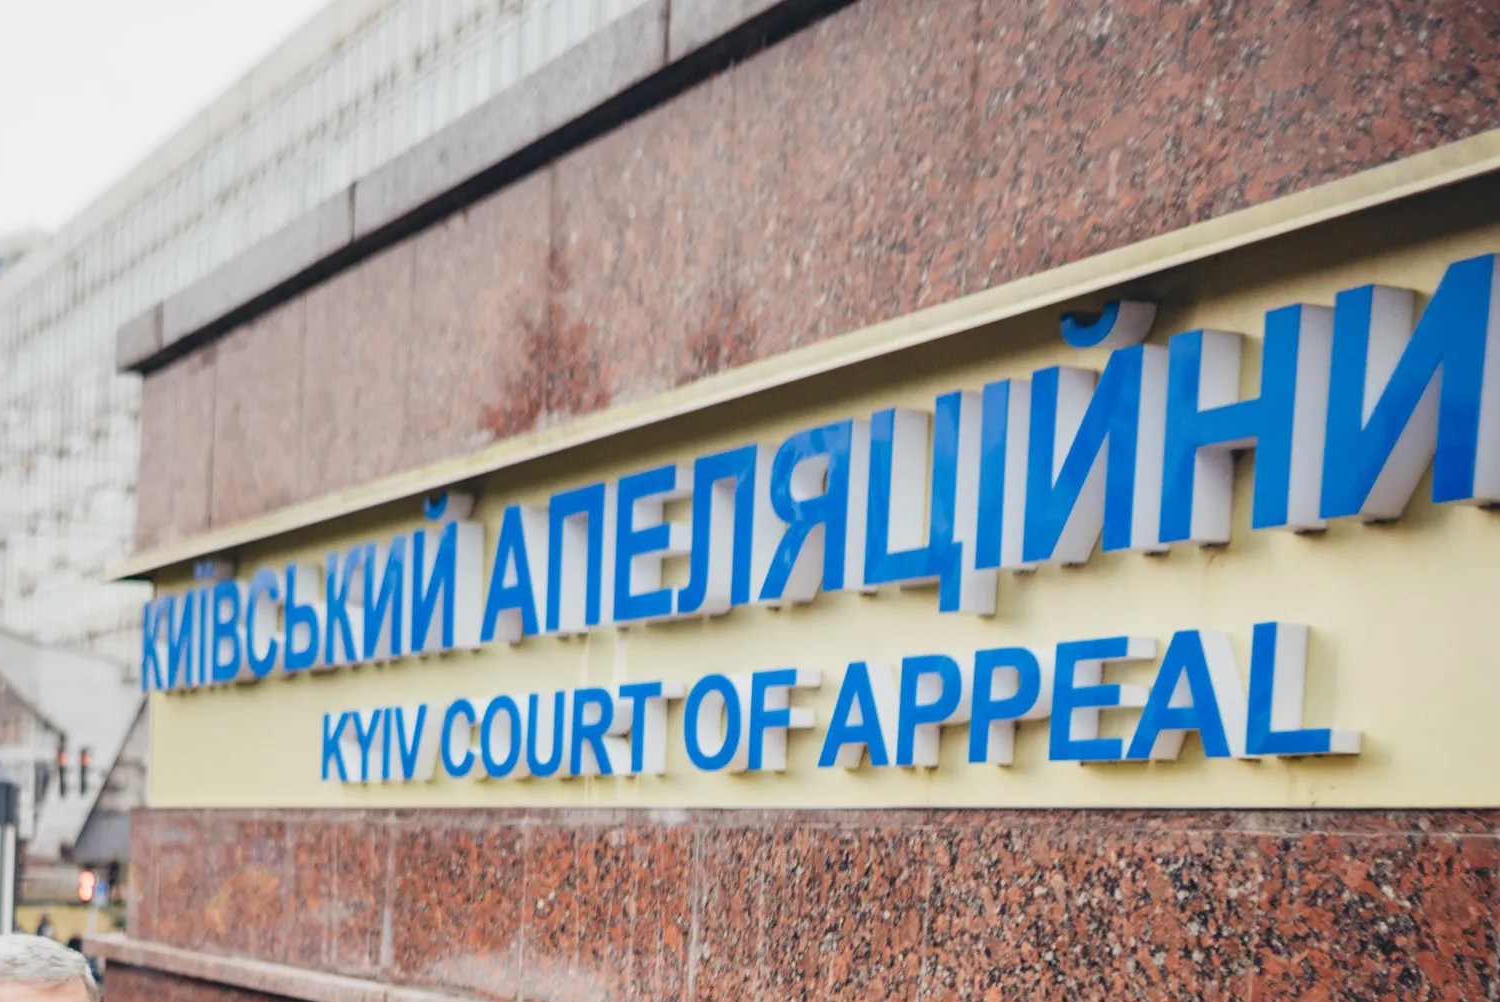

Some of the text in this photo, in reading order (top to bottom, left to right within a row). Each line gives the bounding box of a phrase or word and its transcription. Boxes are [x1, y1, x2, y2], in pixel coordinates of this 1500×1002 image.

[141, 253, 1498, 693] КИЇВСЬКИЙ АПЕЛЯЦІЙНИ
[321, 620, 1332, 782] KYIV COURT OF APPEAL
